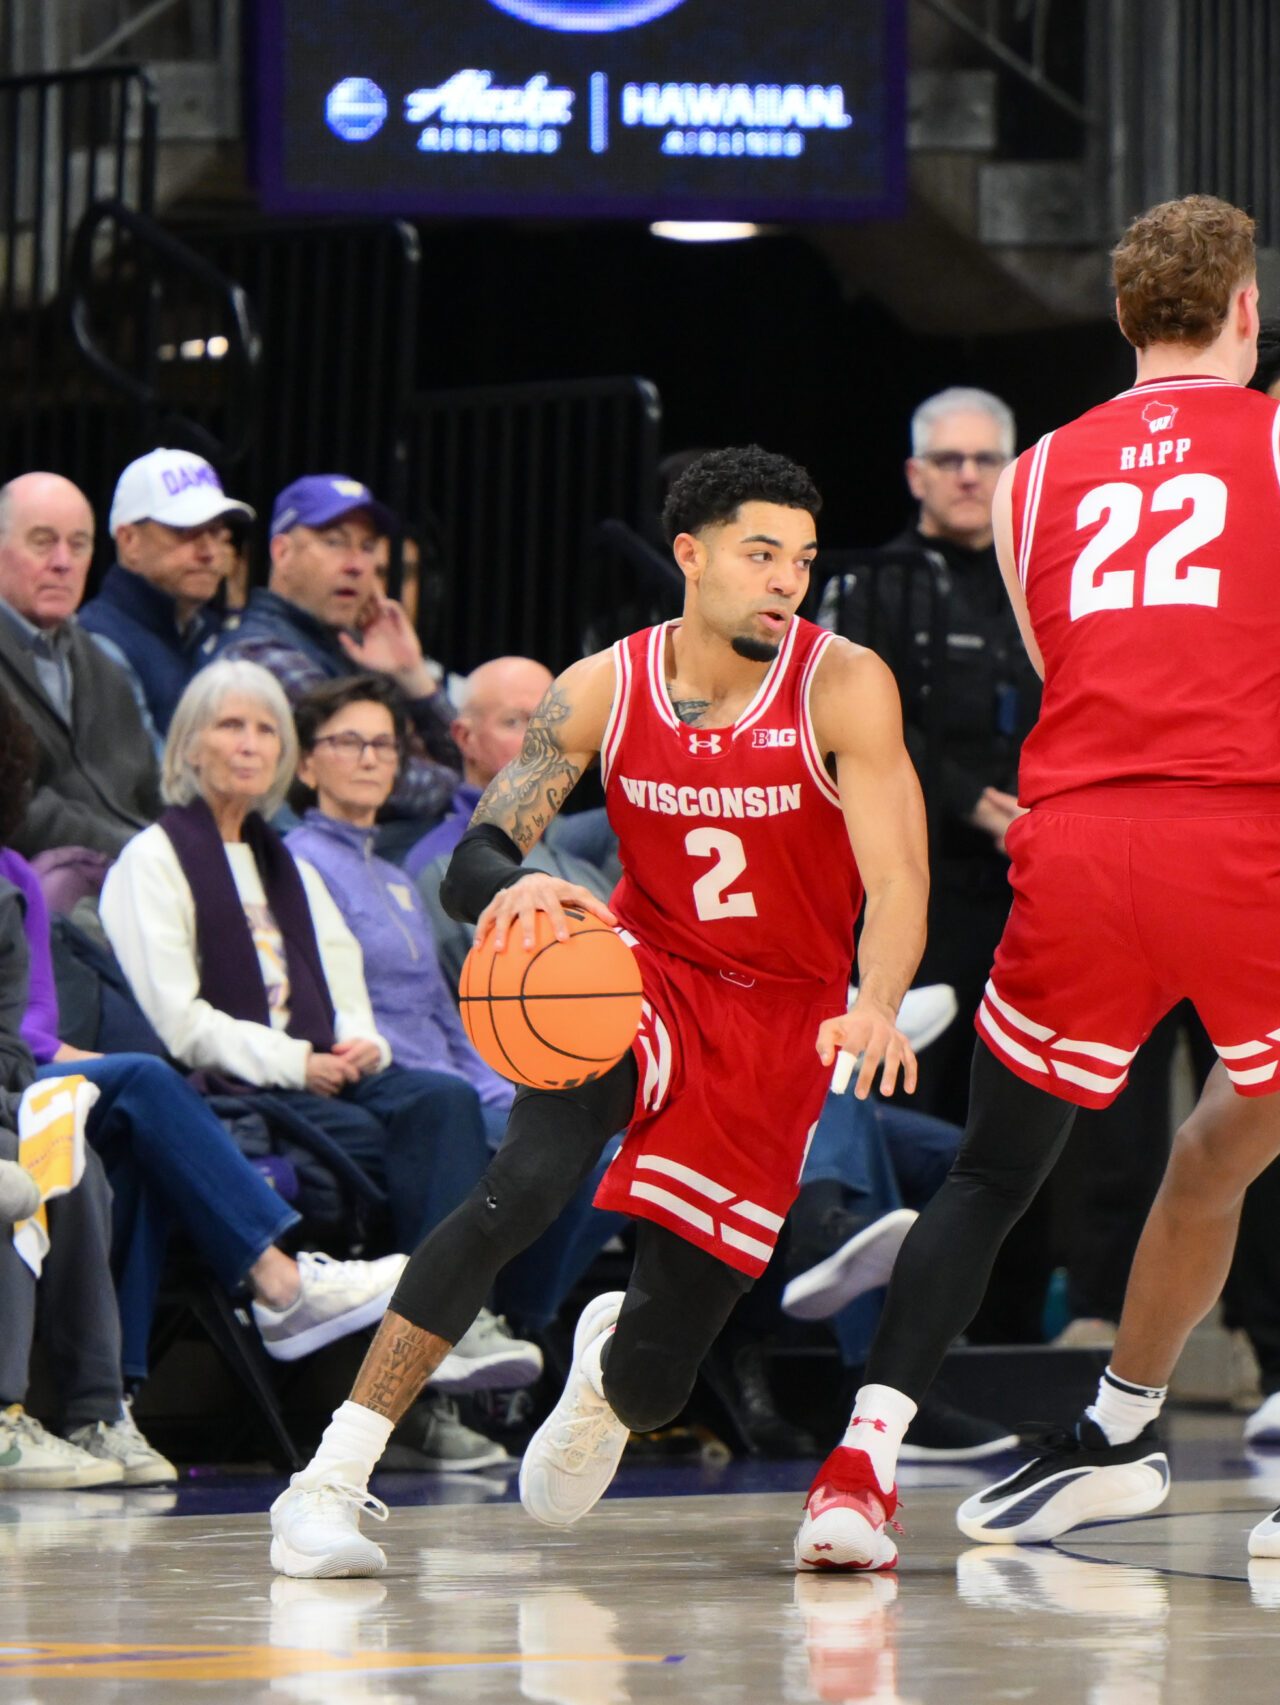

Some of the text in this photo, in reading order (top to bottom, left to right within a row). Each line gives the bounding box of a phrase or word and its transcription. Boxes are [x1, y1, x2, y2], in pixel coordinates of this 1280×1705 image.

[622, 82, 846, 128] HAWAIIAN
[1120, 438, 1191, 470] RAPP
[1069, 473, 1228, 622] 22
[618, 775, 802, 819] WISCONSIN
[684, 826, 758, 921] 2
